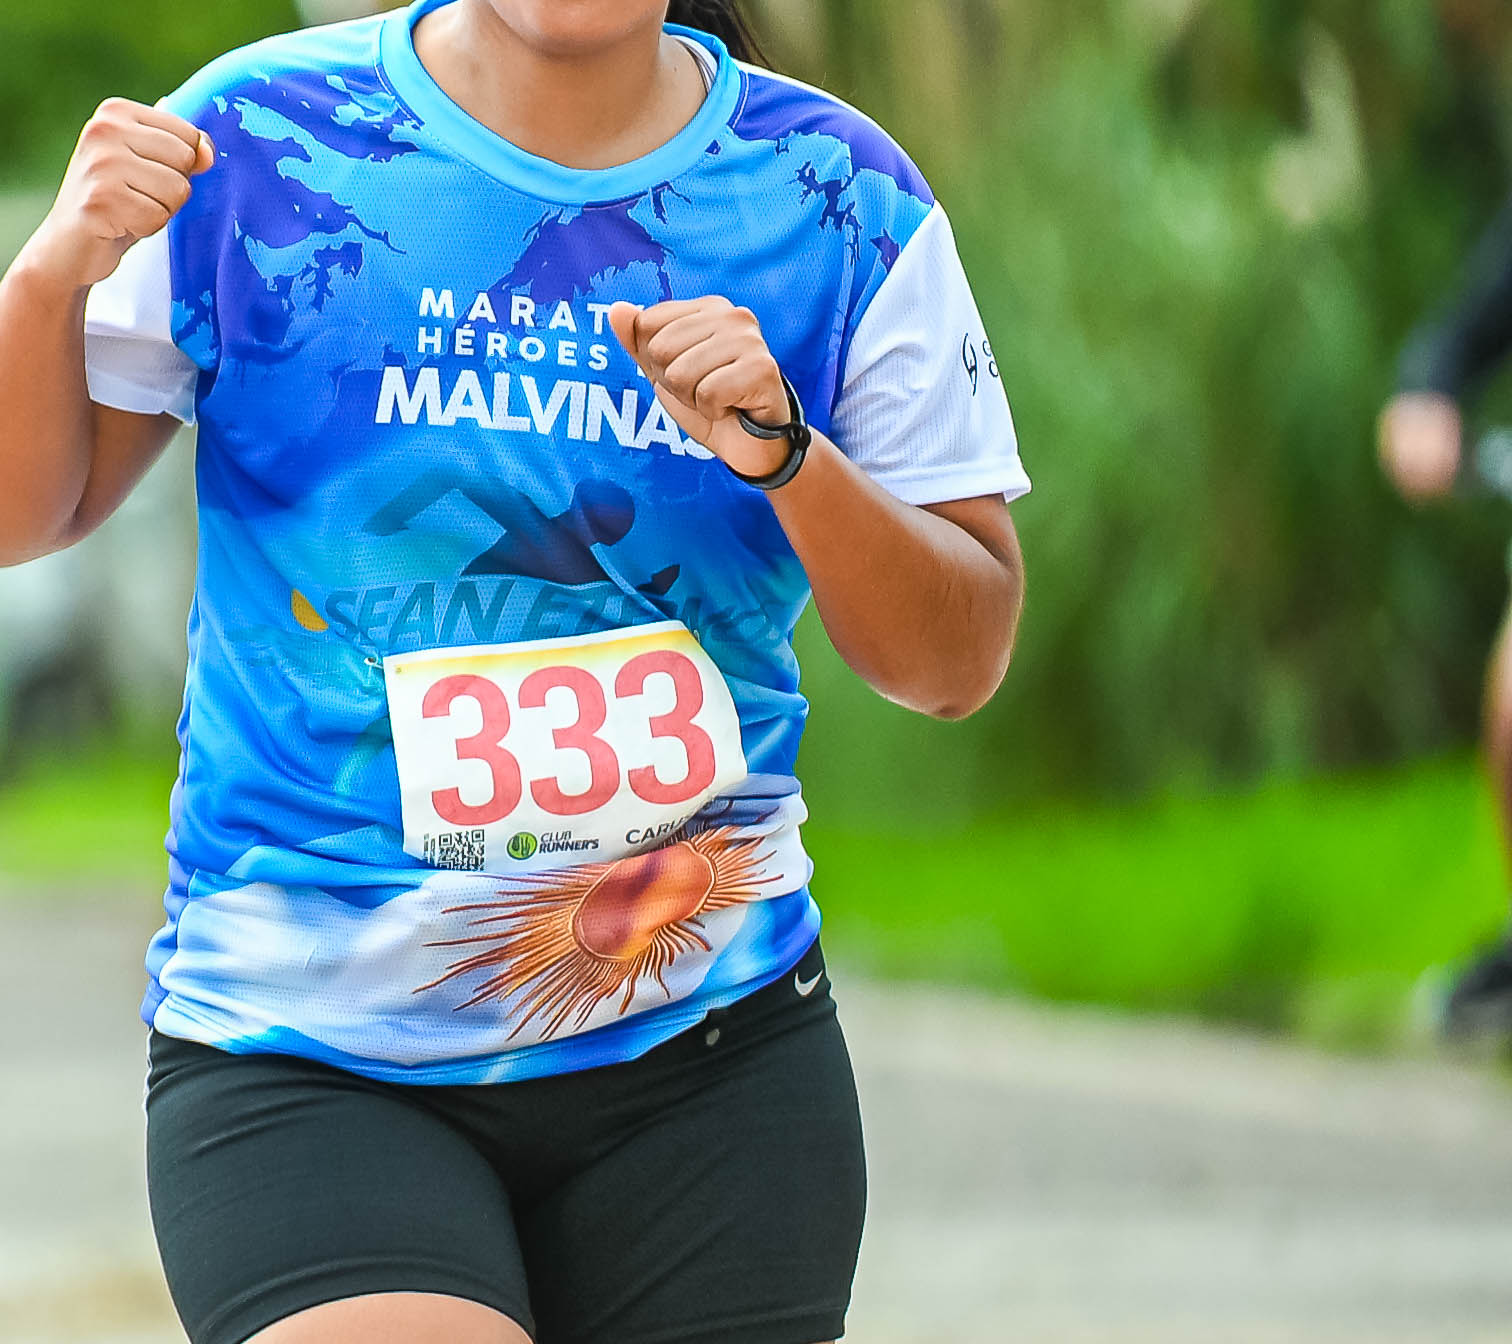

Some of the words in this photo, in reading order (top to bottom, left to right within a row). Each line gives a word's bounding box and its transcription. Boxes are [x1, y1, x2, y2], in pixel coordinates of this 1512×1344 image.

[418, 287, 611, 336] MARAT
[416, 323, 610, 371] HÉROES
[325, 578, 516, 651] SEAN
[421, 649, 716, 826] 333
[539, 838, 599, 854] RUNNER'S
[540, 830, 572, 843] CLUB
